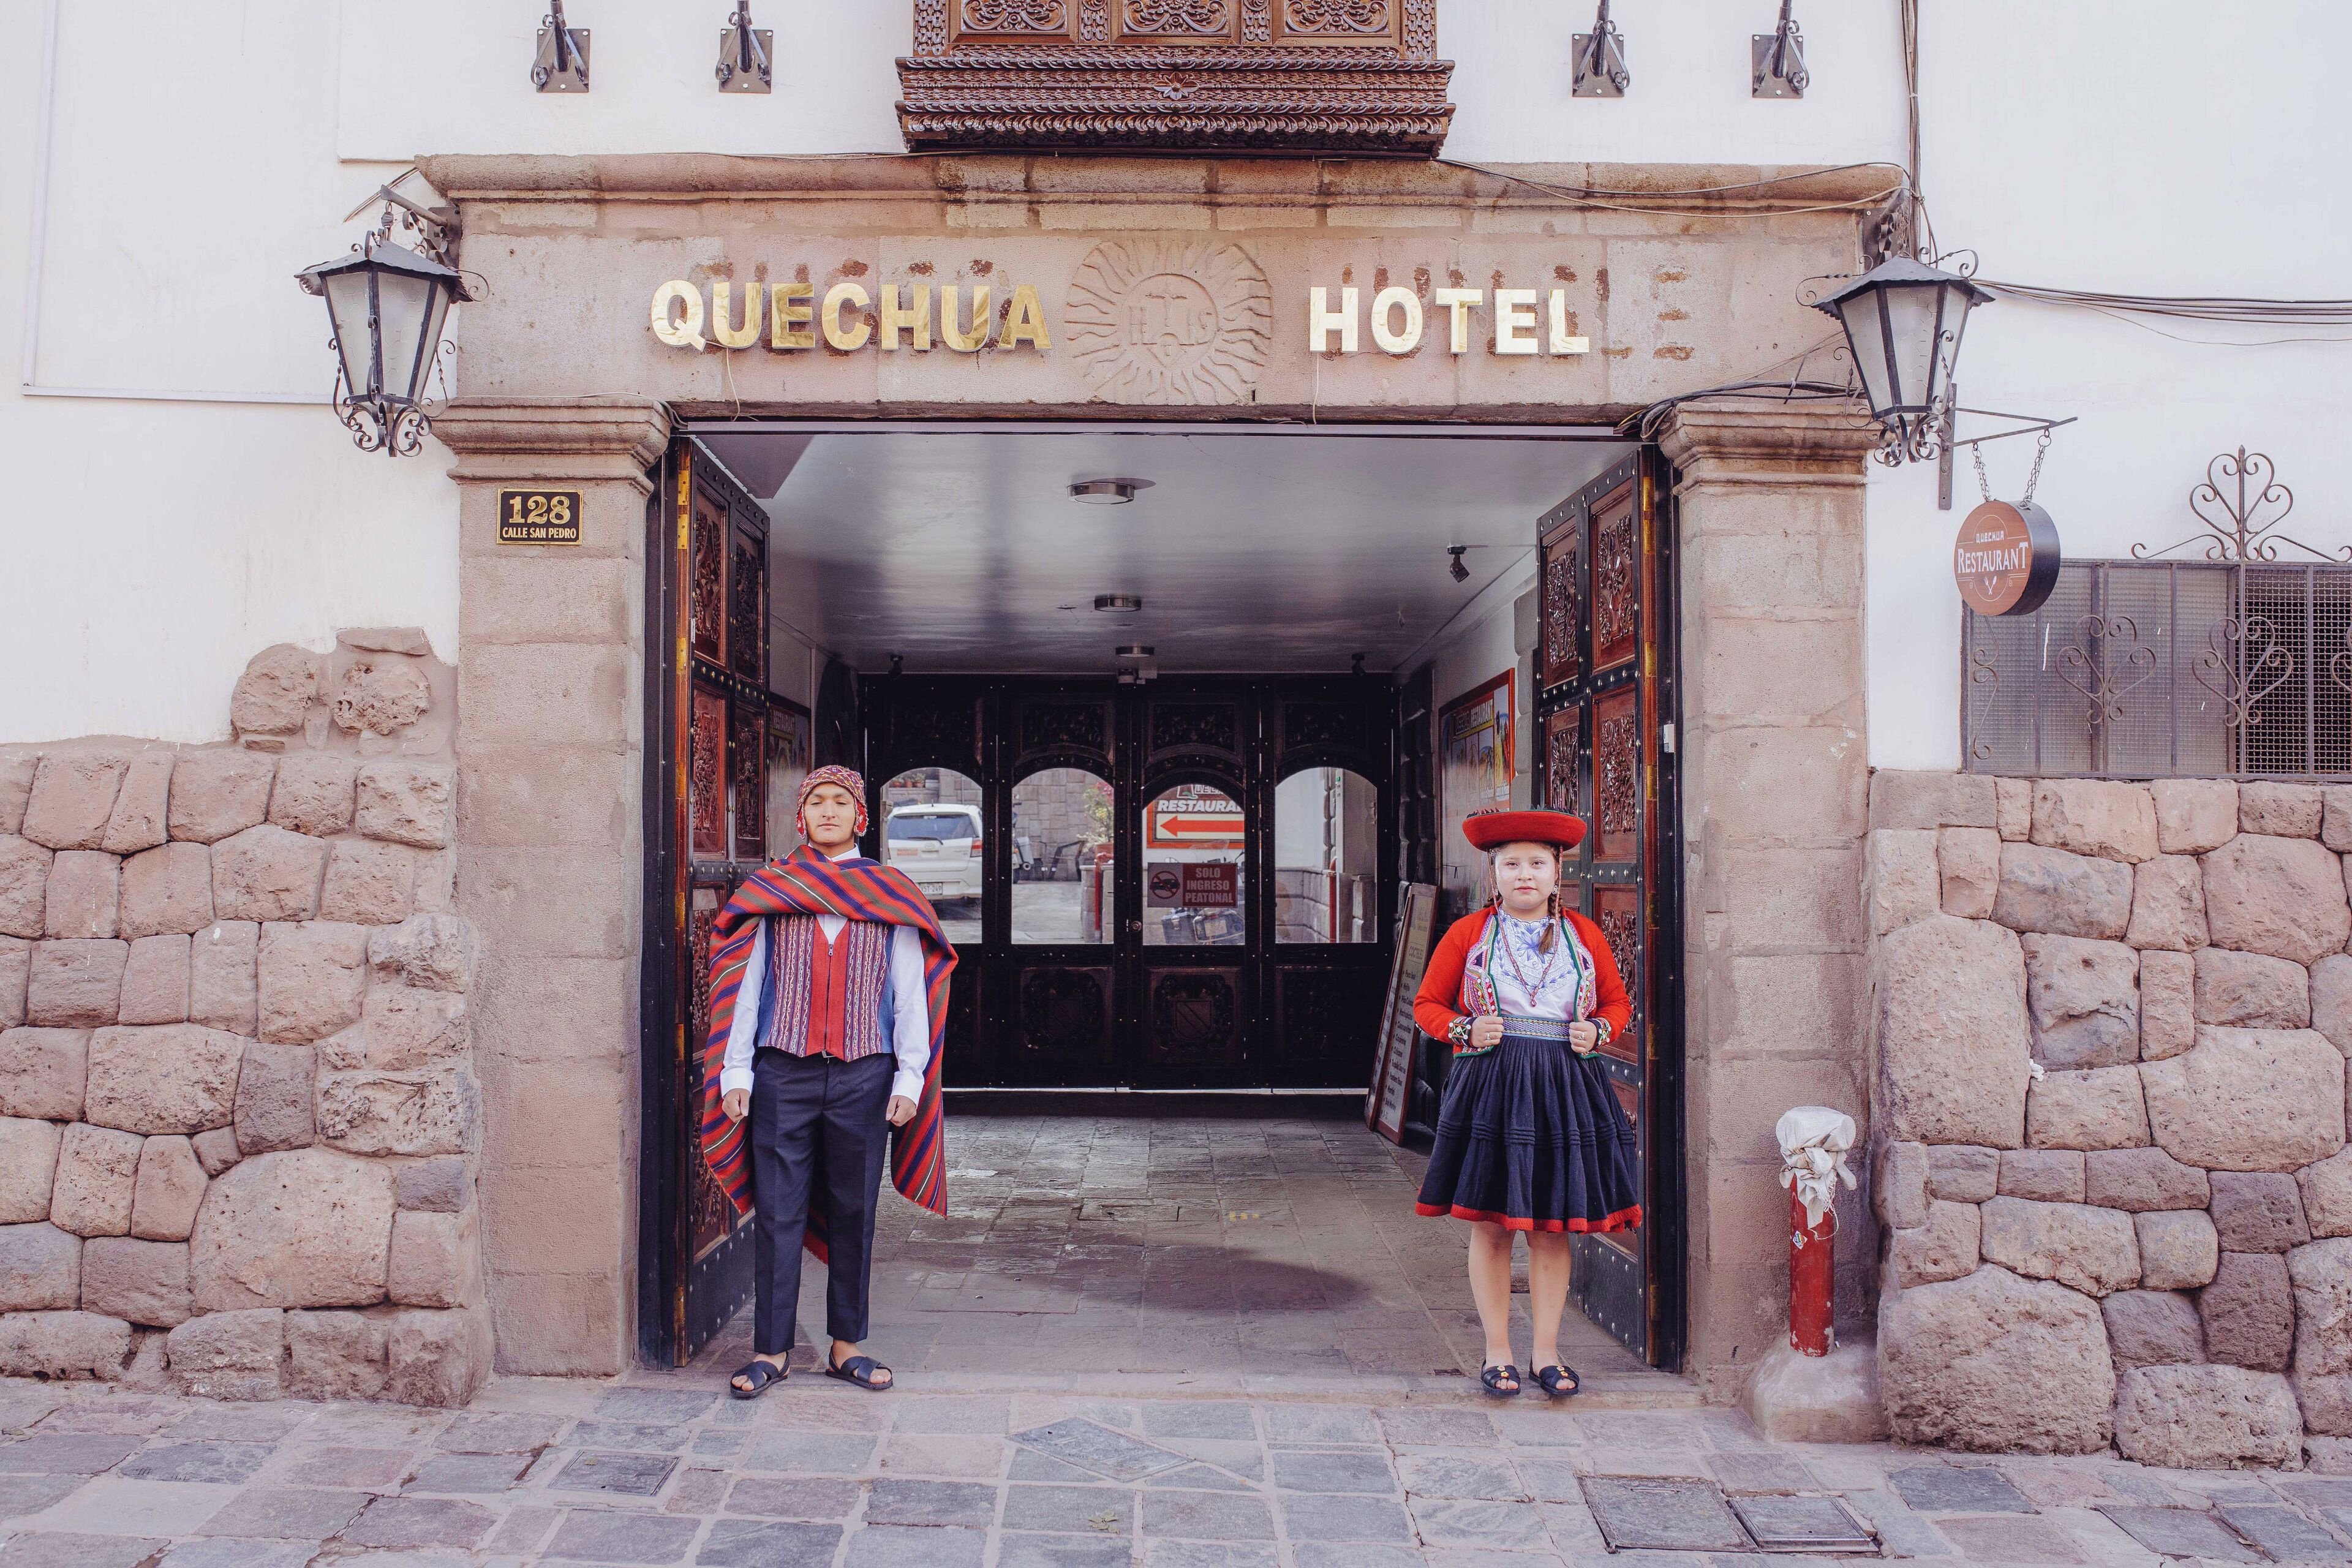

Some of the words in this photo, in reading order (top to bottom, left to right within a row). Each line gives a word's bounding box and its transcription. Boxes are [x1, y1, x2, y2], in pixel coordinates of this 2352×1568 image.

[650, 280, 1051, 352] QUECHUA
[1310, 286, 1589, 355] HOTEL
[509, 496, 571, 524] 128
[502, 527, 527, 538] CALLE
[530, 527, 546, 538] SAN
[548, 527, 576, 538] PEDRO
[1976, 530, 2004, 544] QUECHUA
[1196, 867, 1221, 878] SOLO
[1186, 880, 1230, 891] INGRESO
[1185, 892, 1234, 903] PEATONAL
